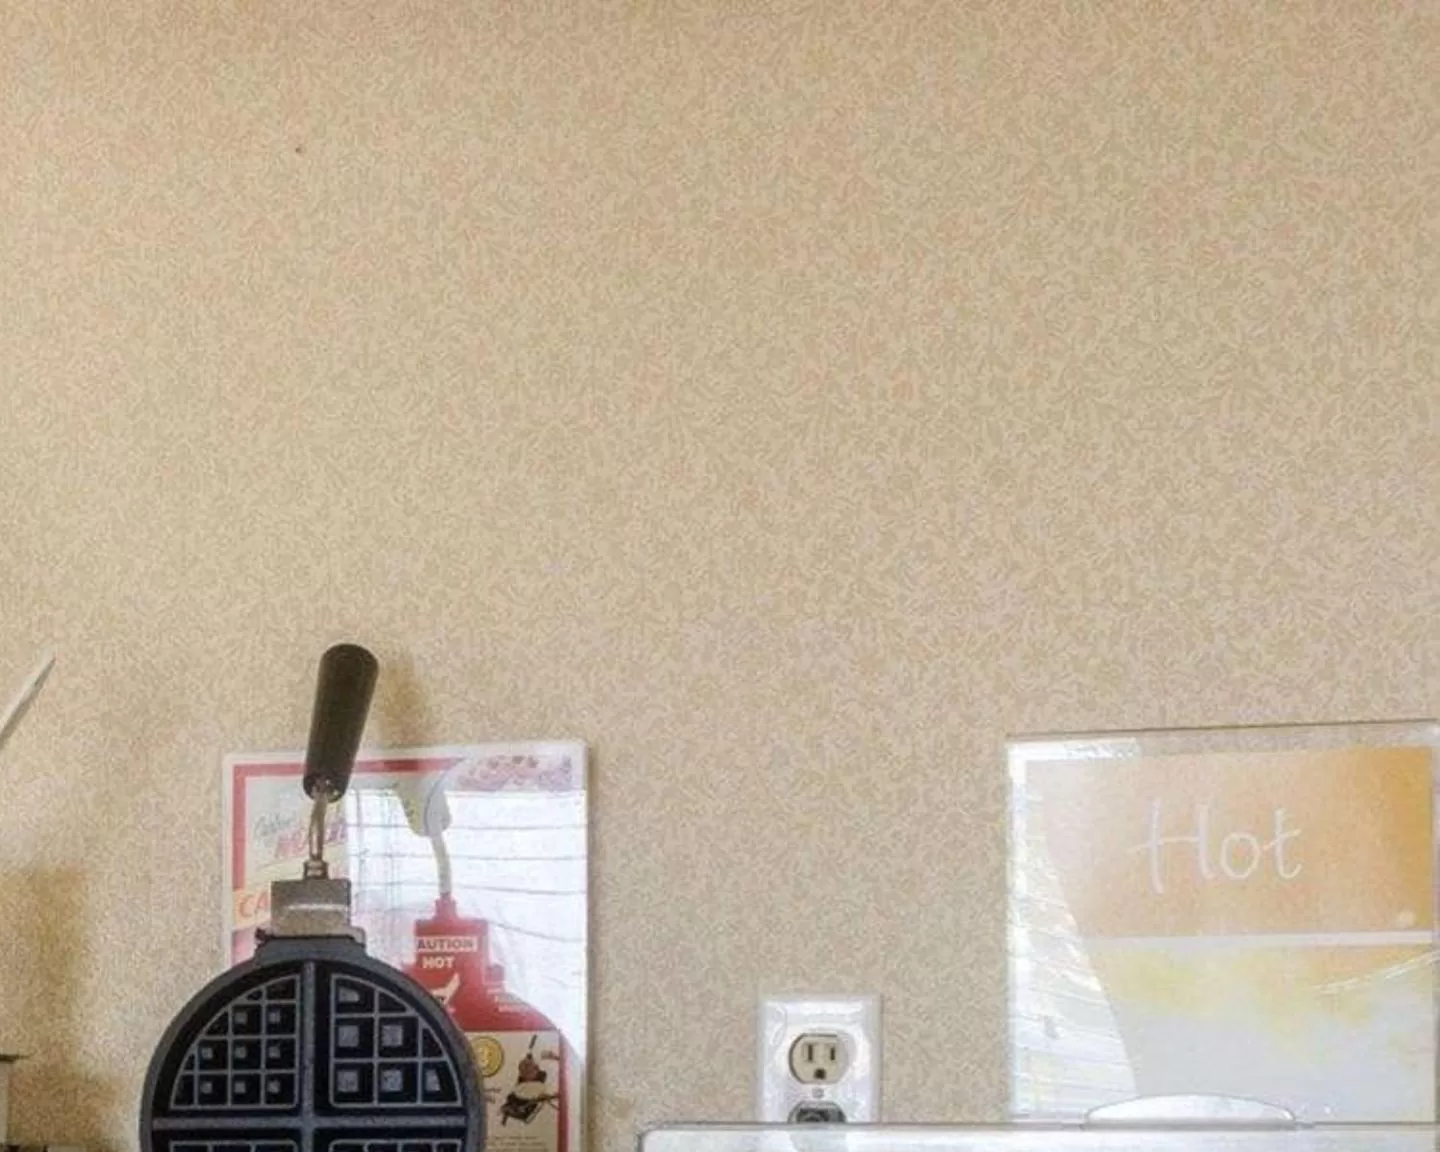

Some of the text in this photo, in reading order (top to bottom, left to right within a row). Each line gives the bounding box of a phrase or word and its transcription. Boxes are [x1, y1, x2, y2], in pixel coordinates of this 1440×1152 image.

[1131, 798, 1303, 894] Hot
[417, 938, 475, 950] AUTION
[421, 955, 456, 969] HOT
